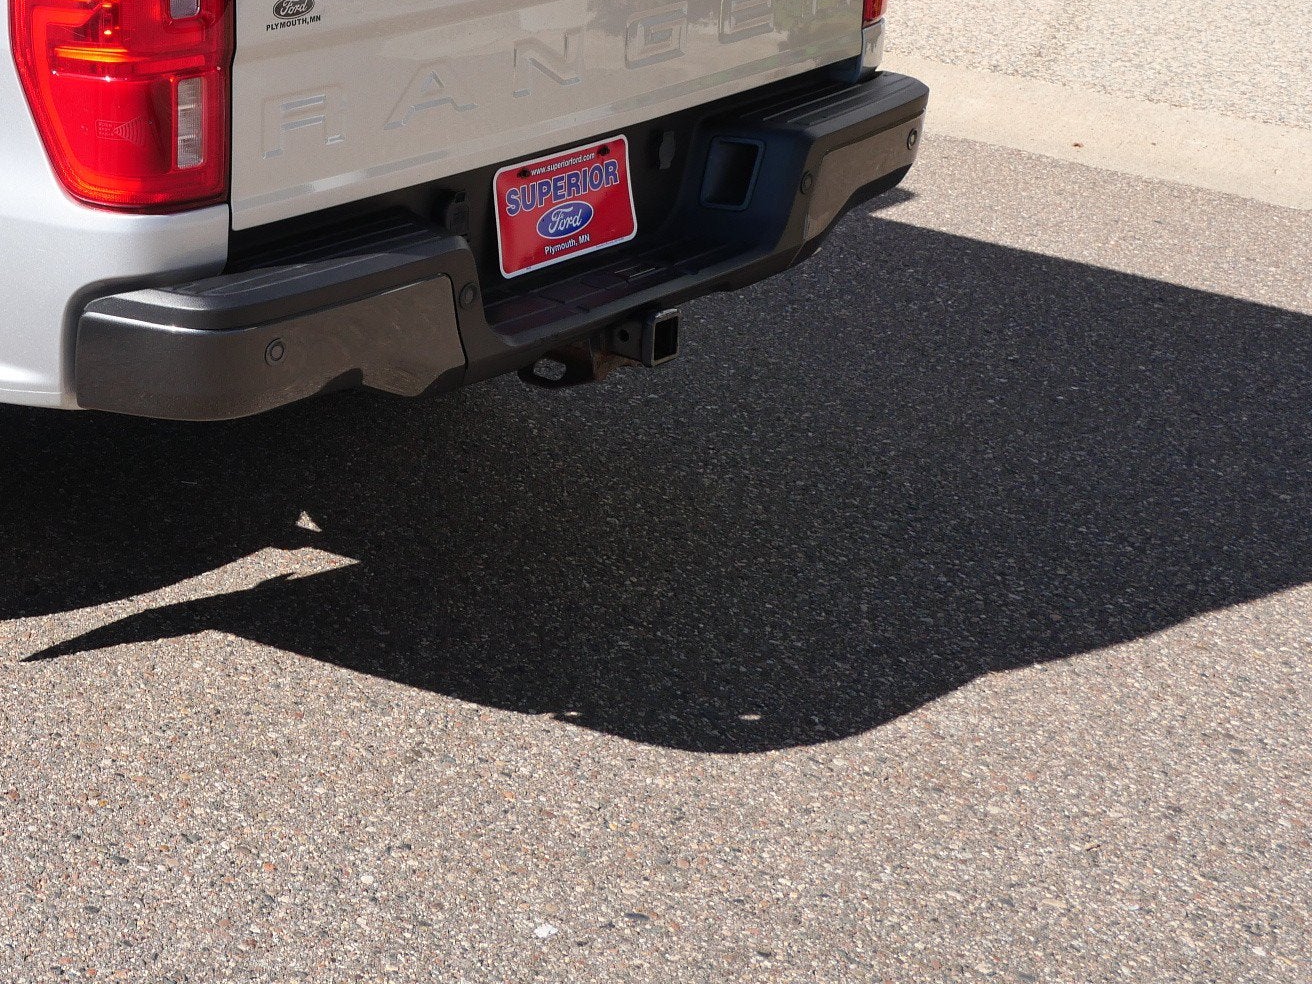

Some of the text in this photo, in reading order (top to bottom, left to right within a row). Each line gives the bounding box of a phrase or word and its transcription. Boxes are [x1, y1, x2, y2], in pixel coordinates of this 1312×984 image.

[530, 152, 595, 176] www.superiorford.com
[505, 159, 619, 217] SUPERIOR
[548, 206, 583, 234] Ford
[544, 233, 591, 255] Plymouth, MN
